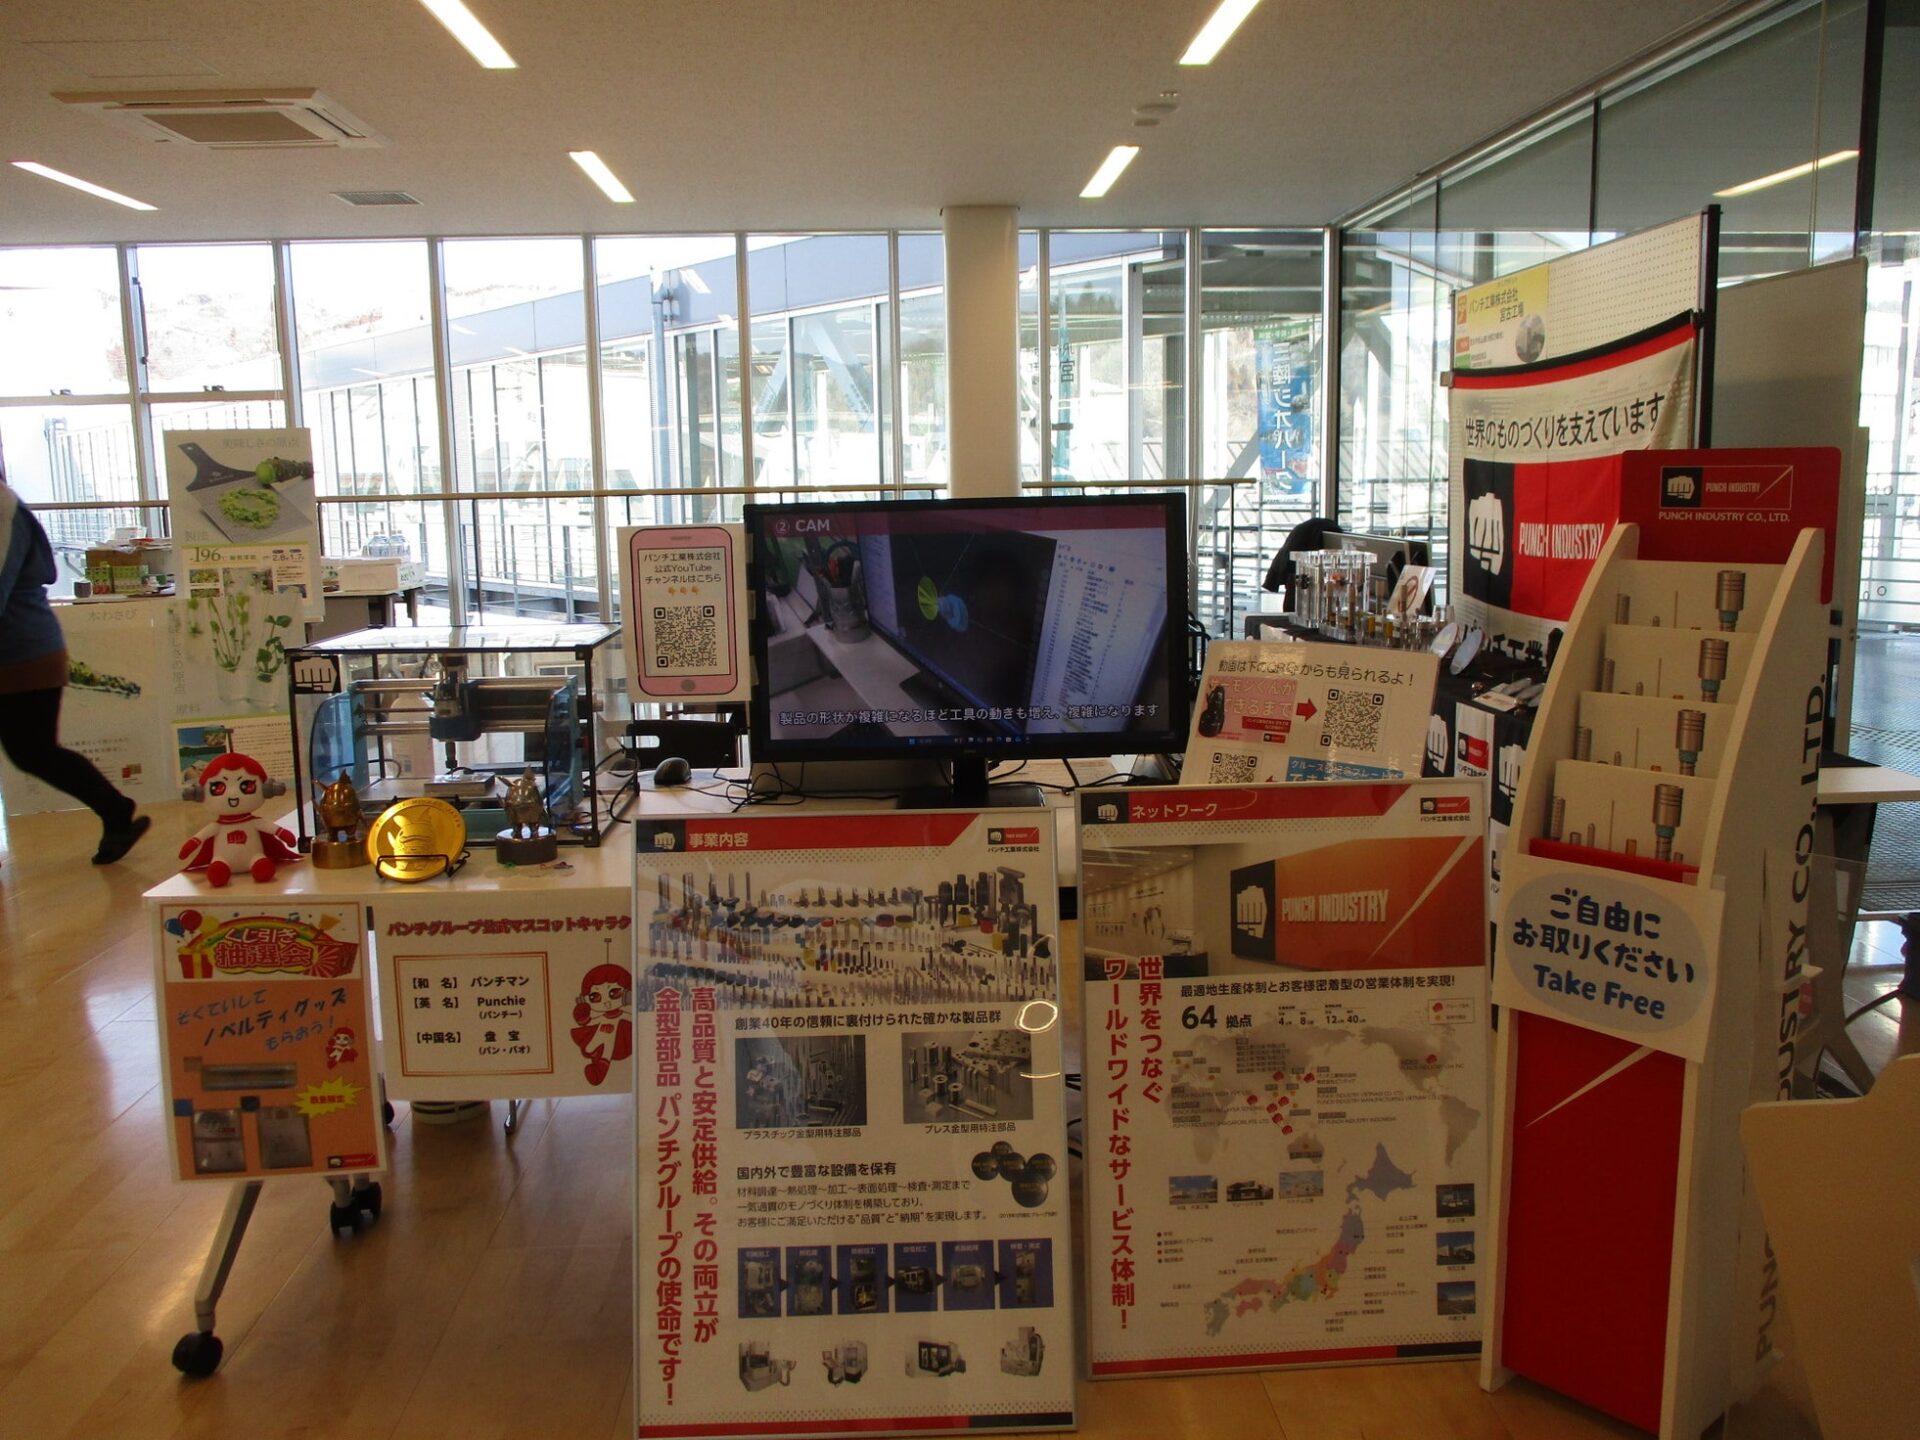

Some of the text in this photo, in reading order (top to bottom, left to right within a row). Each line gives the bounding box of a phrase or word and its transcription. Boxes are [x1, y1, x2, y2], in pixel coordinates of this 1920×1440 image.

[1465, 393, 1665, 449] 世界のものづくりを支えています
[1705, 482, 1761, 493] PUNCH INDUSTRY
[795, 519, 830, 533] CAM
[1658, 511, 1790, 523] PUNCH INDUSTRY CO., LTD.
[1518, 522, 1605, 560] PUNCH INDUSTRY
[644, 552, 721, 562] パンチ工業株式会社
[654, 563, 712, 573] 公式YouTube
[645, 574, 722, 584] チャンネルはこちら
[779, 703, 1160, 726] 製品の形状が複雑になるほど工具の動きも増え、複雑になります
[1800, 673, 1827, 786] LTD.
[1132, 801, 1218, 818] ネットワーク
[688, 832, 748, 848] 事業内容
[1281, 889, 1389, 923] PUNCH INDUSTRY
[1550, 887, 1661, 939] ご自由に
[224, 927, 297, 944] くじ引き
[215, 943, 314, 969] 抽選会
[1513, 918, 1694, 983] お取りください
[470, 976, 529, 988] パンチマン
[1534, 963, 1665, 1019] Take Free
[477, 995, 526, 1007] Punchie
[204, 988, 347, 1046] ノベルティグッズ
[735, 1010, 1001, 1032] 創業40年の信頼に裏付けられた確かな製品群
[1181, 1005, 1252, 1029] 64 拠点
[416, 1031, 461, 1044] 【中国名】
[1138, 956, 1164, 1104] 世界をつなぐ
[743, 1127, 861, 1140] プラスチック金型用特注部品
[925, 1121, 1016, 1134] プレス金型用特注部品
[691, 986, 719, 1343] 高品質と安定供給。その両立が
[737, 1162, 896, 1180] 国内外で豊富な設備を保有
